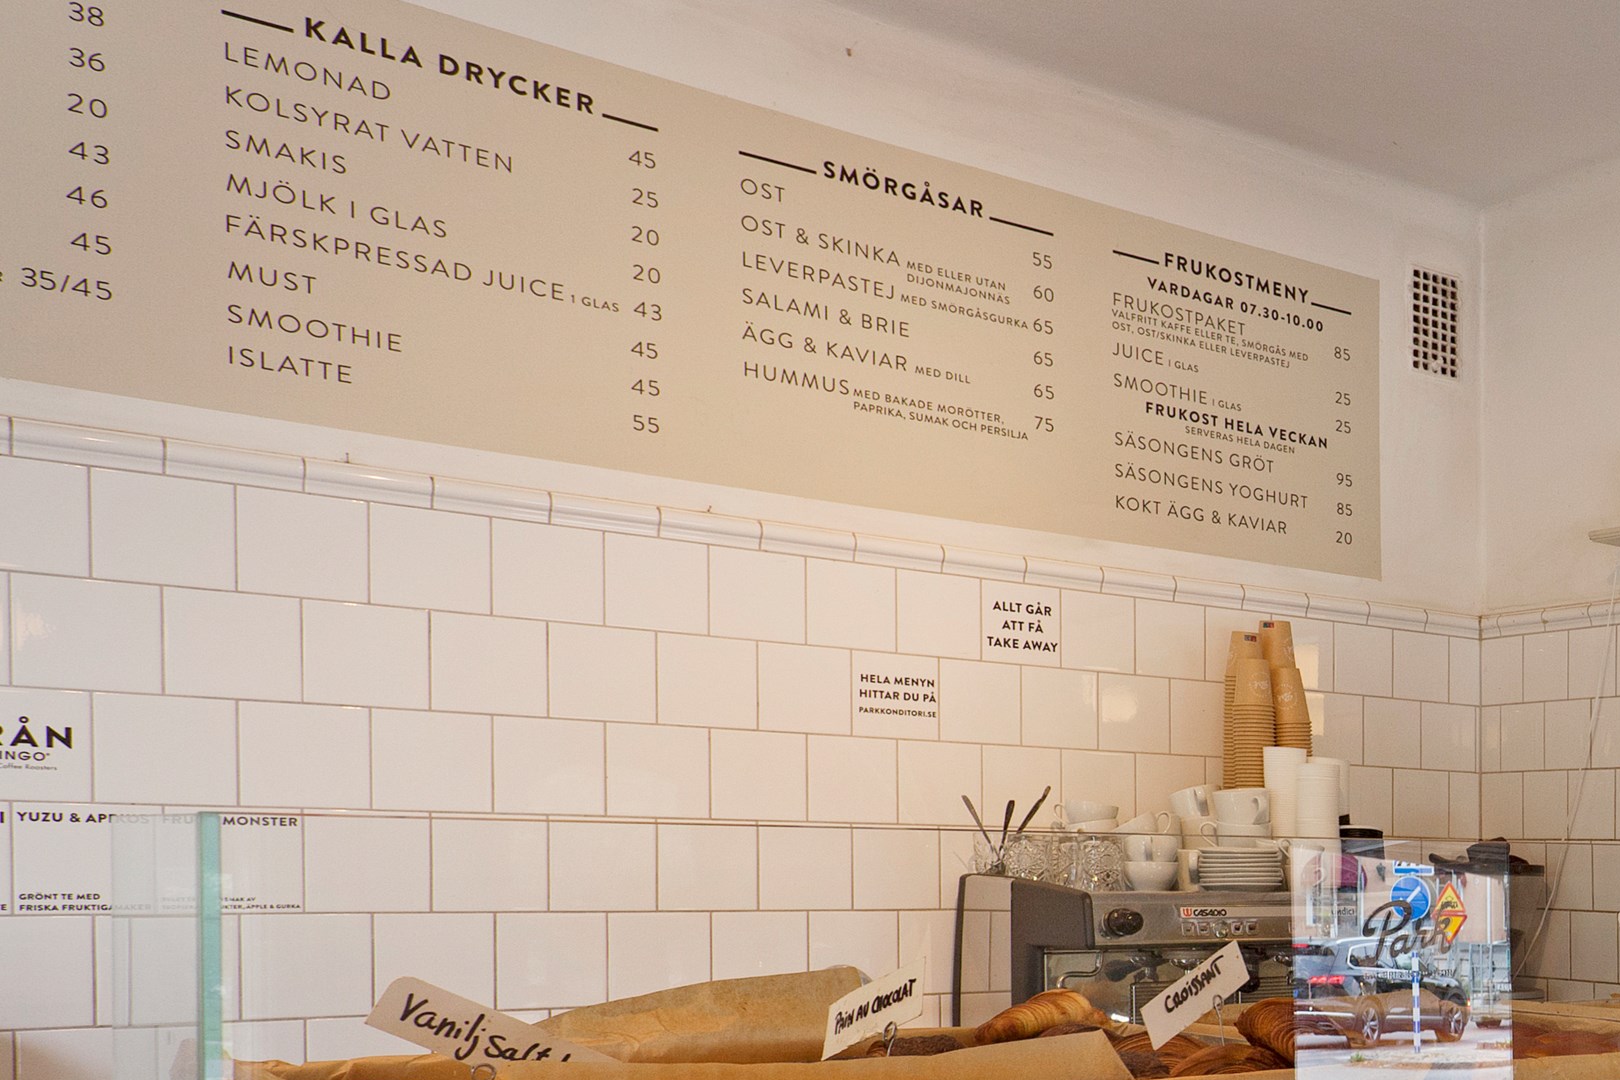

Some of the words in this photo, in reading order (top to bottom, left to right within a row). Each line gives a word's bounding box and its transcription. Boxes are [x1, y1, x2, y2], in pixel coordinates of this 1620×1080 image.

[68, 1, 105, 27] 38
[68, 47, 105, 72] 36
[305, 17, 423, 68] KALLA
[438, 53, 594, 115] DRYCKER
[67, 93, 108, 119] 20
[224, 41, 390, 100] LEMONAD
[628, 150, 656, 169] 45
[68, 141, 110, 165] 43
[225, 85, 390, 142] KOLSYRAT
[400, 129, 512, 173] VATTEN
[632, 188, 659, 208] 25
[65, 186, 108, 209] 46
[225, 130, 347, 174] SMAKIS
[631, 226, 659, 246] 20
[823, 160, 983, 218] SMÖRGÅSAR
[69, 232, 112, 255] 45
[226, 173, 336, 215] MJÖLK
[370, 206, 447, 238] GLAS
[633, 264, 661, 284] 20
[740, 178, 786, 203] OST
[1033, 252, 1052, 270] 55
[741, 215, 786, 239] OST
[818, 233, 900, 267] SKINKA
[20, 267, 112, 300] 35/45
[226, 214, 472, 281] FÄRSKPRESSAD
[482, 269, 564, 301] JUICE
[581, 296, 619, 312] GLAS
[633, 301, 662, 321] 43
[906, 260, 933, 274] MED
[937, 267, 971, 283] ELLER
[976, 276, 1005, 291] UTAN
[907, 273, 1010, 305] DIJONMAJONNÄS
[1033, 285, 1054, 302] 60
[1164, 252, 1309, 303] FRUKOSTMENY
[227, 261, 317, 294] MUST
[630, 341, 658, 359] 45
[742, 251, 894, 299] LEVERPASTEJ
[900, 293, 927, 306] MED
[931, 300, 1028, 329] SMÖRGÅSGURKA
[1033, 318, 1053, 335] 65
[1113, 292, 1246, 336] FRUKOSTPAKET
[1147, 276, 1234, 310] VARDAGAR
[1240, 301, 1323, 332] 07.30-10.00
[227, 304, 402, 353] SMOOTHIE
[631, 379, 660, 397] 45
[742, 288, 828, 320] SALAMI
[862, 313, 909, 338] BRIE
[1033, 351, 1053, 367] 65
[1111, 309, 1157, 327] VALFRITT
[1161, 320, 1191, 335] KAFFE
[1194, 328, 1222, 342] ELLER
[1225, 334, 1239, 347] TE,
[1241, 339, 1286, 356] SMÖRGÅS
[1288, 350, 1309, 361] MED
[1334, 346, 1351, 361] 85
[1137, 327, 1196, 347] OST/SKINKA
[1199, 340, 1227, 355] ELLER
[1230, 347, 1290, 368] LEVERPASTEJ
[742, 321, 793, 349] ÄGG
[827, 341, 907, 372] KAVIAR
[915, 365, 941, 378] MED
[946, 371, 971, 384] DILL
[1034, 384, 1054, 400] 65
[1112, 342, 1164, 366] JUICE
[1174, 361, 1199, 373] GLAS
[1335, 391, 1351, 406] 25
[228, 346, 352, 384] ISLATTE
[633, 414, 659, 434] 55
[744, 361, 849, 395] HUMMUS
[853, 388, 880, 401] MED
[885, 394, 933, 411] BAKADE
[937, 404, 1004, 425] MORÖTTER,
[1114, 373, 1207, 405] SMOOTHIE
[1218, 400, 1242, 412] GLAS
[1336, 419, 1351, 434] 25
[853, 401, 906, 420] PAPRIKA,
[909, 411, 949, 427] SUMAK
[952, 419, 977, 431] OCH
[980, 424, 1028, 440] PERSILJA
[1034, 416, 1054, 432] 75
[1146, 401, 1218, 427] FRUKOST
[1225, 417, 1263, 436] HELA
[1268, 426, 1327, 449] VECKAN
[1185, 426, 1233, 442] SERVERAS
[1237, 436, 1260, 447] HELA
[1264, 441, 1295, 454] DAGEN
[1114, 430, 1223, 464] SÄSONGENS
[1229, 453, 1274, 473] GRÖT
[1336, 473, 1352, 487] 95
[1115, 462, 1223, 494] SÄSONGENS
[1229, 483, 1308, 509] YOGHURT
[1337, 502, 1352, 516] 85
[1116, 495, 1161, 515] KOKT
[1167, 500, 1204, 522] ÄGG
[1228, 513, 1287, 535] KAVIAR
[1336, 531, 1352, 545] 20
[992, 601, 1023, 614] ALLT
[1025, 602, 1053, 617] GÅR
[1002, 620, 1024, 632] ATT
[1028, 620, 1044, 634] FÅ
[986, 636, 1020, 649] TAKE
[1022, 640, 1059, 653] AWAY
[859, 688, 900, 701] HITTAR
[903, 691, 920, 702] DU
[922, 691, 937, 703] PÅ
[860, 673, 891, 685] HELA
[893, 676, 936, 688] MENYN
[858, 706, 937, 718] PARKKONDITORI.SE
[17, 811, 63, 823] YUZU
[222, 816, 298, 827] MONSTER
[19, 892, 58, 900] GRÖNT
[1362, 900, 1452, 963] Park
